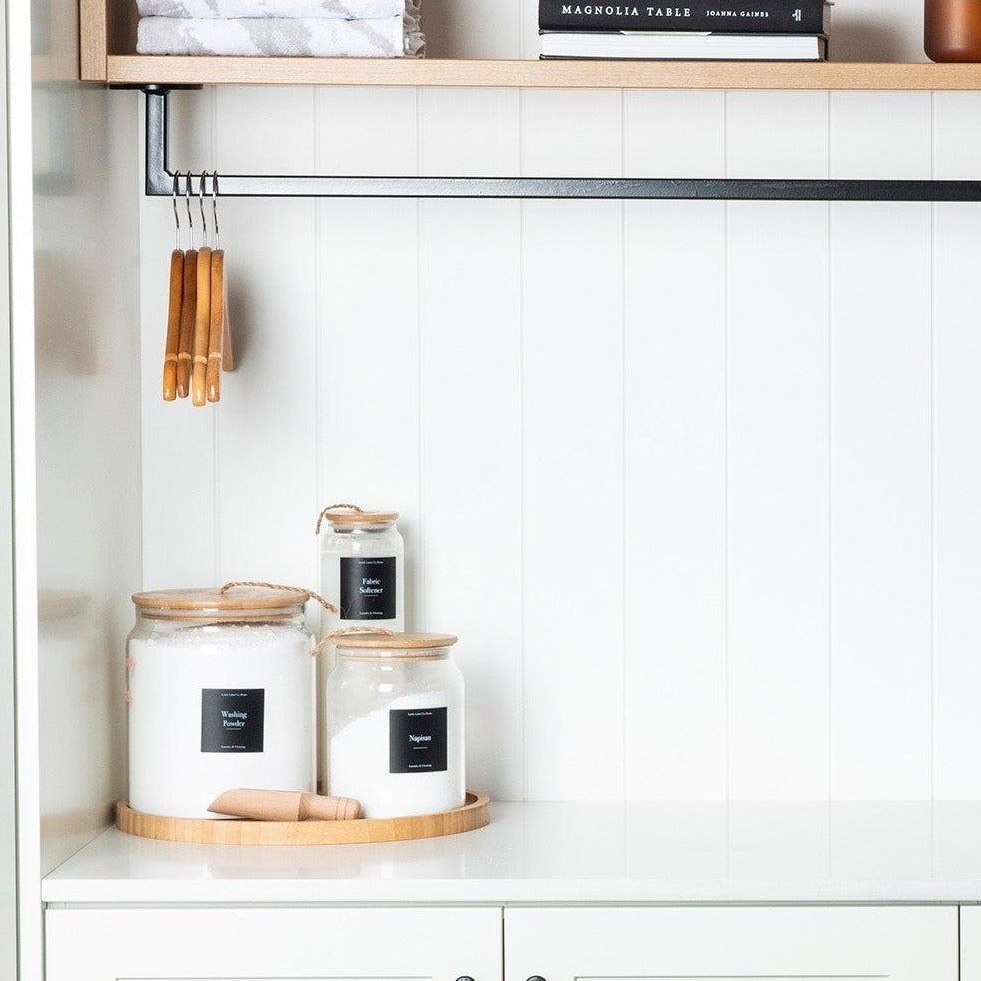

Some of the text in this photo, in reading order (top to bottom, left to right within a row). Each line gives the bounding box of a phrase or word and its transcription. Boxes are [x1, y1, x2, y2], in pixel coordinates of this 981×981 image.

[561, 4, 639, 16] MAGNOLIA
[646, 6, 691, 17] TABLE
[362, 577, 382, 585] Fabric
[359, 586, 384, 594] Softener
[221, 710, 248, 720] Washing
